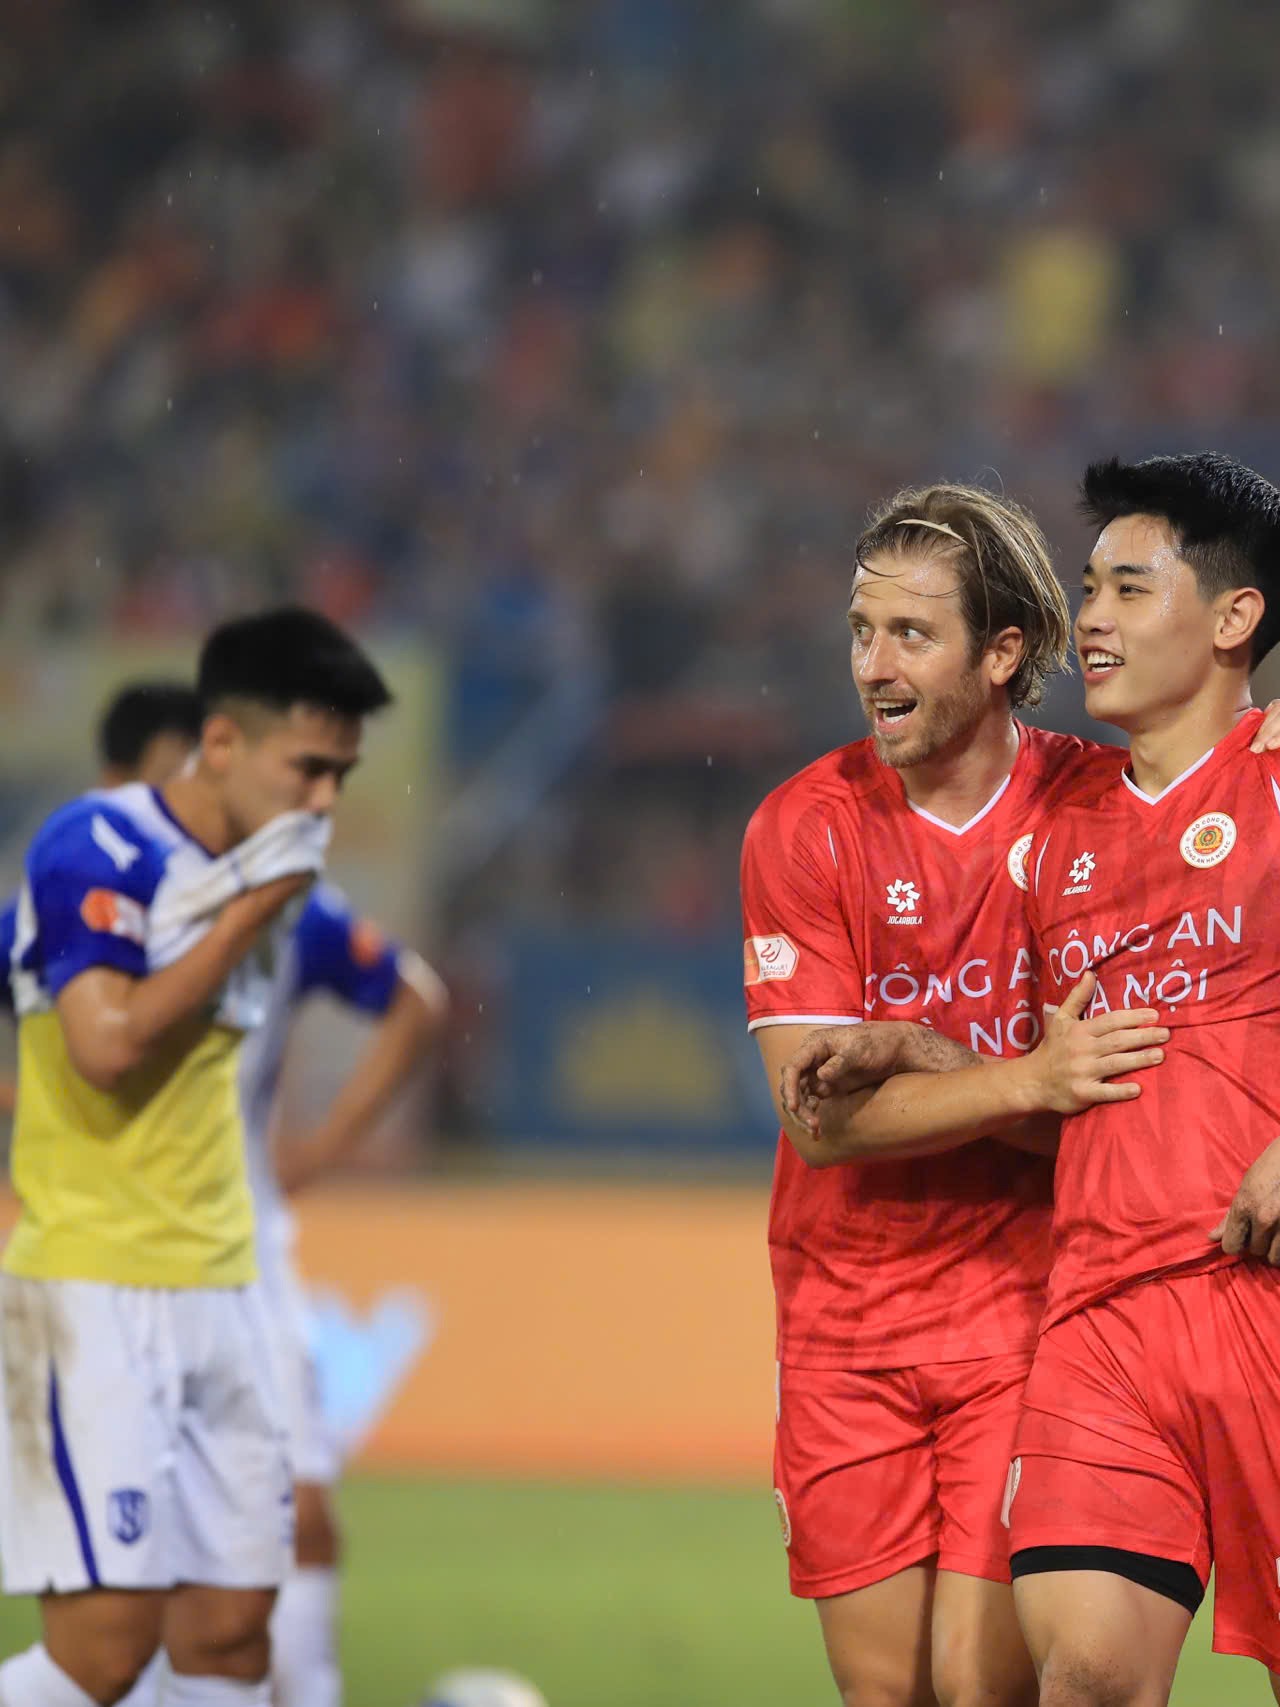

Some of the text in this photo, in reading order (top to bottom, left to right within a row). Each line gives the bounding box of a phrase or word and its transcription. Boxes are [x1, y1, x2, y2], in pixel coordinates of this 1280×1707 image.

[886, 915, 923, 925] JOGARBOLA
[1048, 905, 1243, 986] CÔNG AN
[864, 947, 1039, 1012] CÔNG A
[1123, 959, 1209, 1013] NỘI
